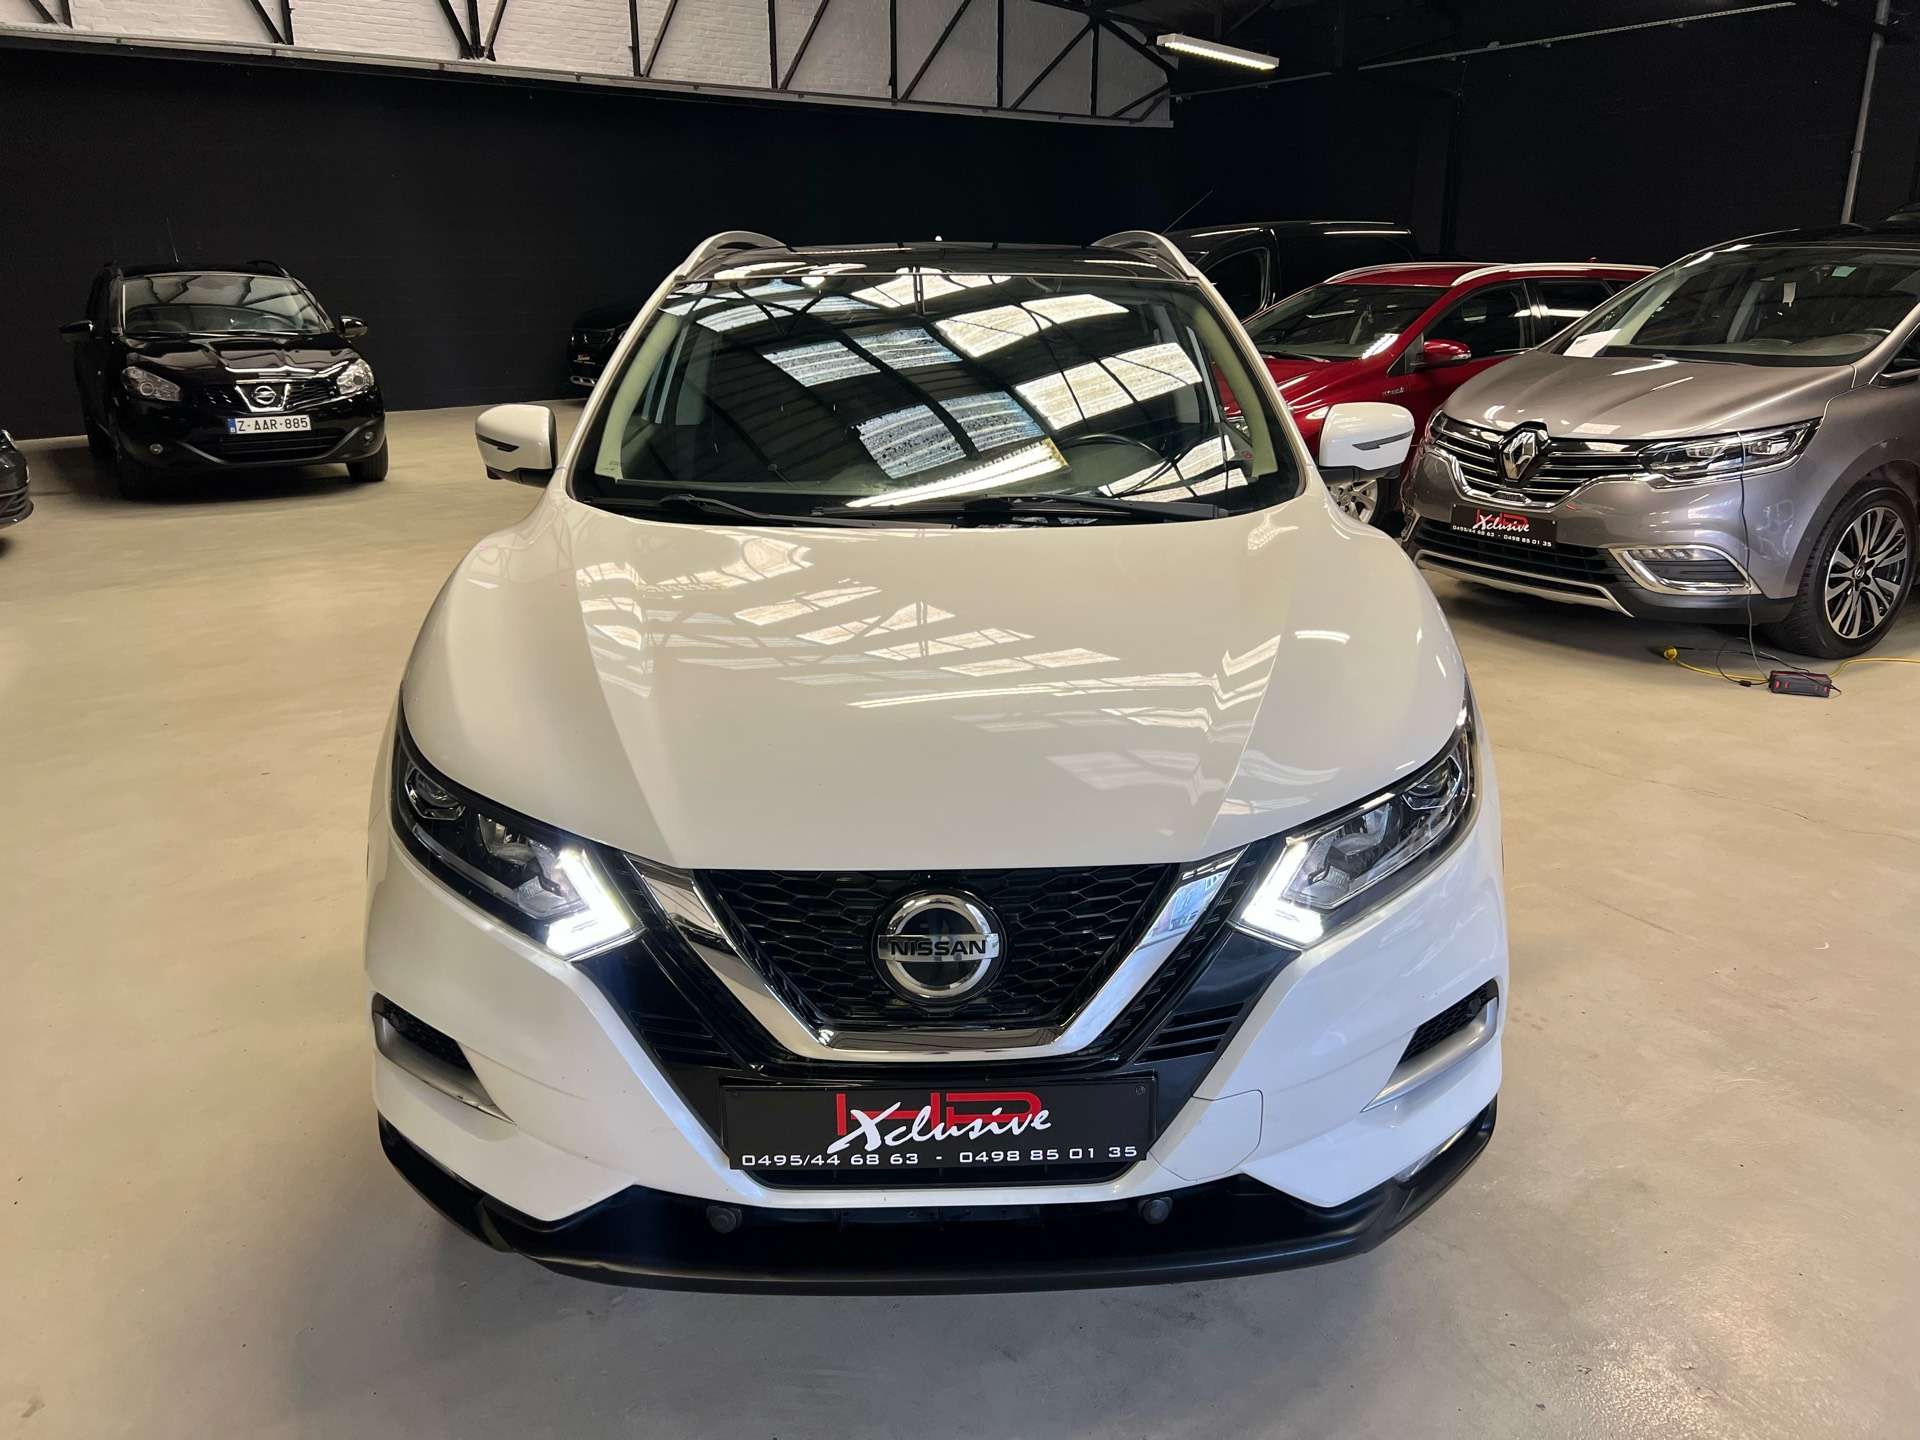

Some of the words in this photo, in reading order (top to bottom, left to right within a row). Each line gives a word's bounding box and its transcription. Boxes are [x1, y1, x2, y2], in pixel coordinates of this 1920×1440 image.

[1472, 514, 1530, 532] Xclusive
[890, 940, 986, 956] NISSAN
[827, 1101, 1052, 1154] Xclusive
[741, 1153, 841, 1167] 0495/44
[850, 1153, 880, 1166] 68
[890, 1152, 919, 1165] 63
[959, 1148, 1020, 1163] 0498
[1030, 1147, 1060, 1161] 85
[1069, 1147, 1096, 1160] 01
[1108, 1145, 1138, 1159] 35
